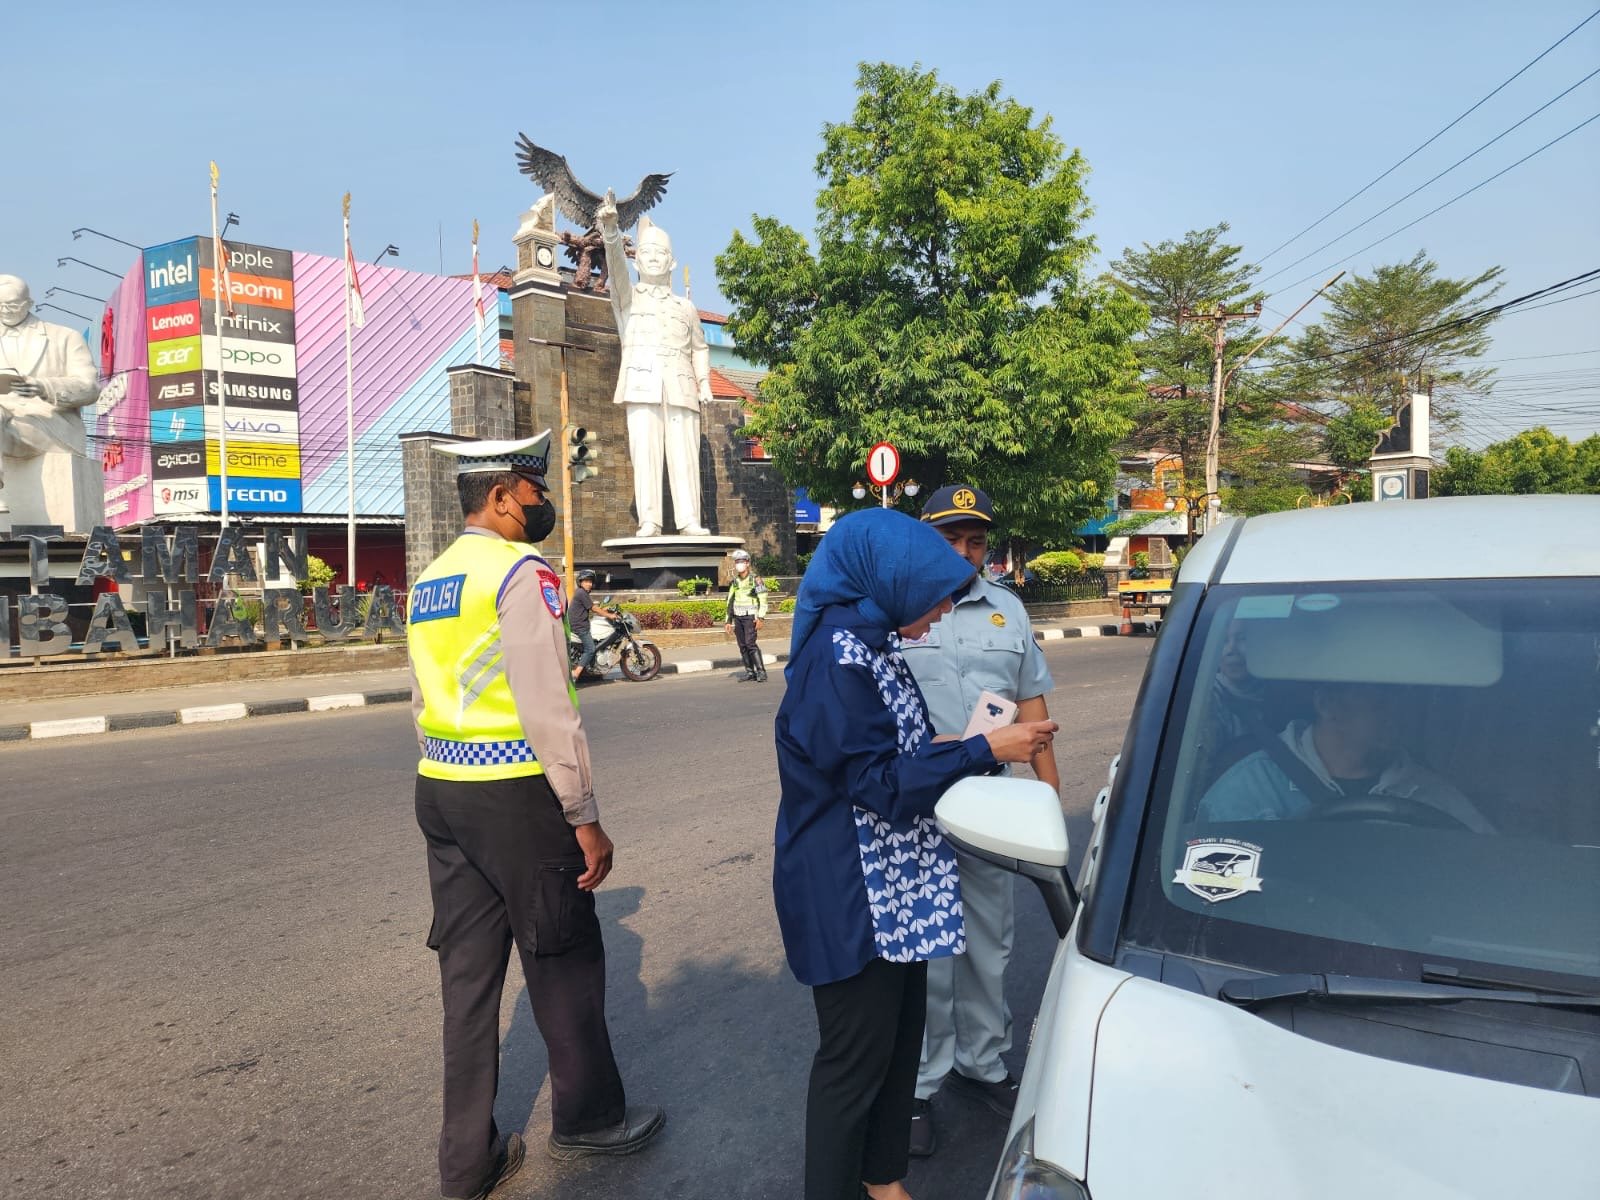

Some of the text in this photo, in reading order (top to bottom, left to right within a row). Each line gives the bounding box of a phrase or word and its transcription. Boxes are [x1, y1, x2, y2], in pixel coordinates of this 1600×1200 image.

[226, 250, 273, 269] pple
[150, 254, 193, 289] intel
[211, 278, 283, 300] xaomi
[152, 313, 194, 331] Lenovo
[156, 346, 194, 366] acer
[220, 348, 281, 365] oppo
[158, 382, 195, 400] ASUS
[209, 382, 292, 401] SAMSUNG
[169, 412, 185, 441] hp
[224, 417, 281, 433] vivo
[226, 452, 287, 468] ealme
[173, 488, 199, 501] msi
[226, 488, 287, 503] TECNO
[11, 524, 308, 586] TAMAN
[411, 580, 460, 617] POLISI
